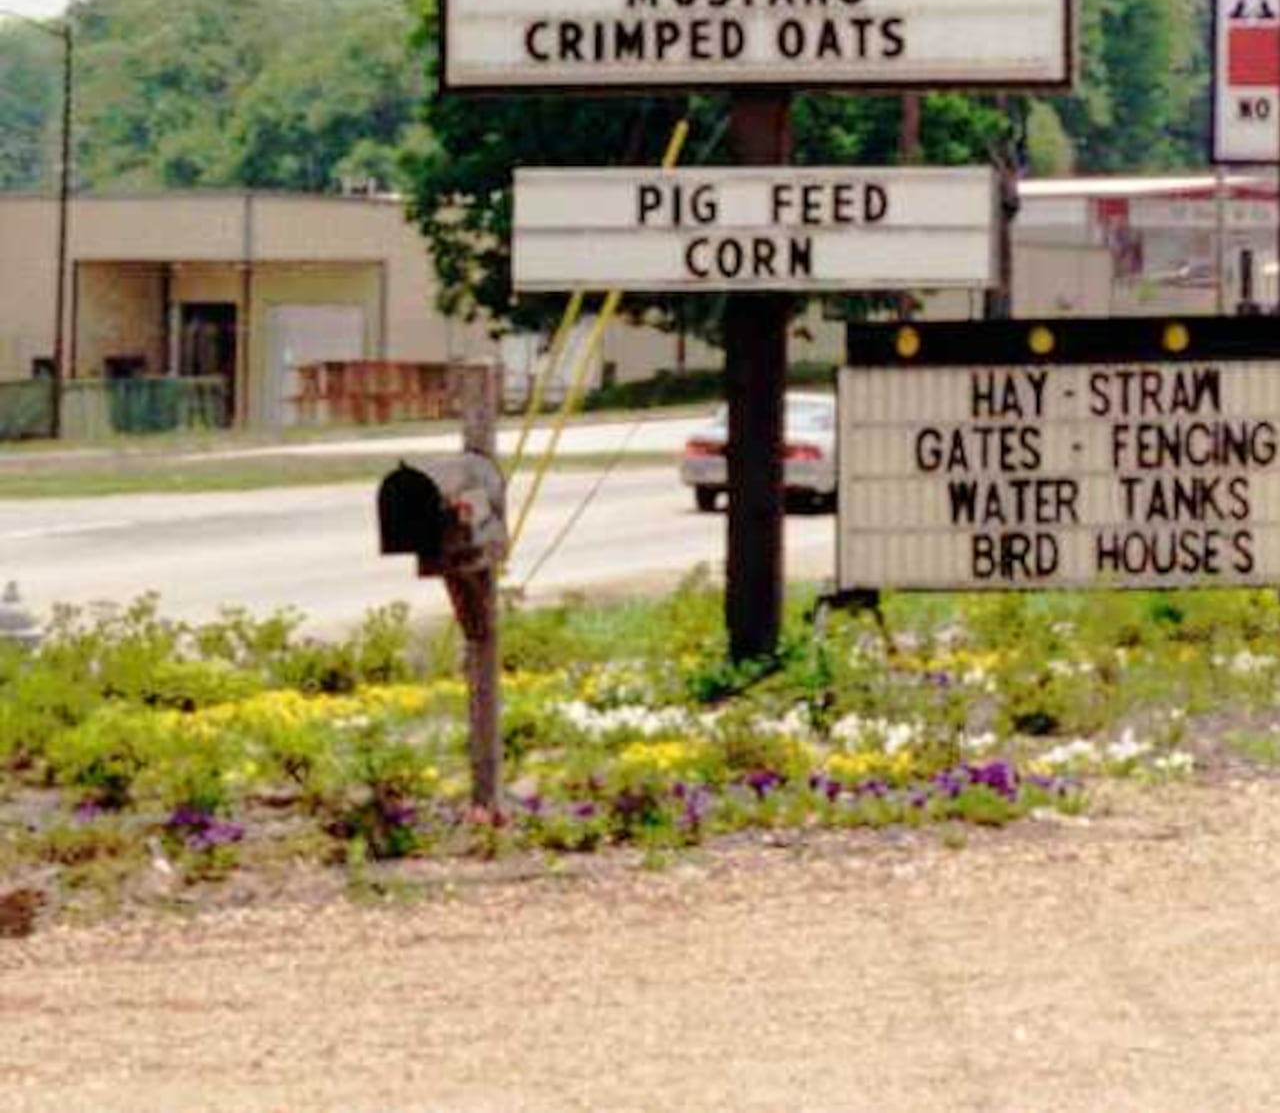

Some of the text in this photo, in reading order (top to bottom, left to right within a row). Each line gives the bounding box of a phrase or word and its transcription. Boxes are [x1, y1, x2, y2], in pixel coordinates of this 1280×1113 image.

[524, 18, 906, 61] CRIMPED OATS
[1237, 97, 1271, 120] NO
[637, 183, 888, 225] PIG FEED
[686, 237, 815, 279] CORN
[970, 371, 1050, 418] HAY
[1090, 370, 1222, 415] STRAW
[915, 427, 1043, 473] GATES
[1111, 421, 1278, 468] FENCING
[948, 477, 1251, 525] WATER TANKS
[971, 530, 1255, 580] BIRD HOUSES
